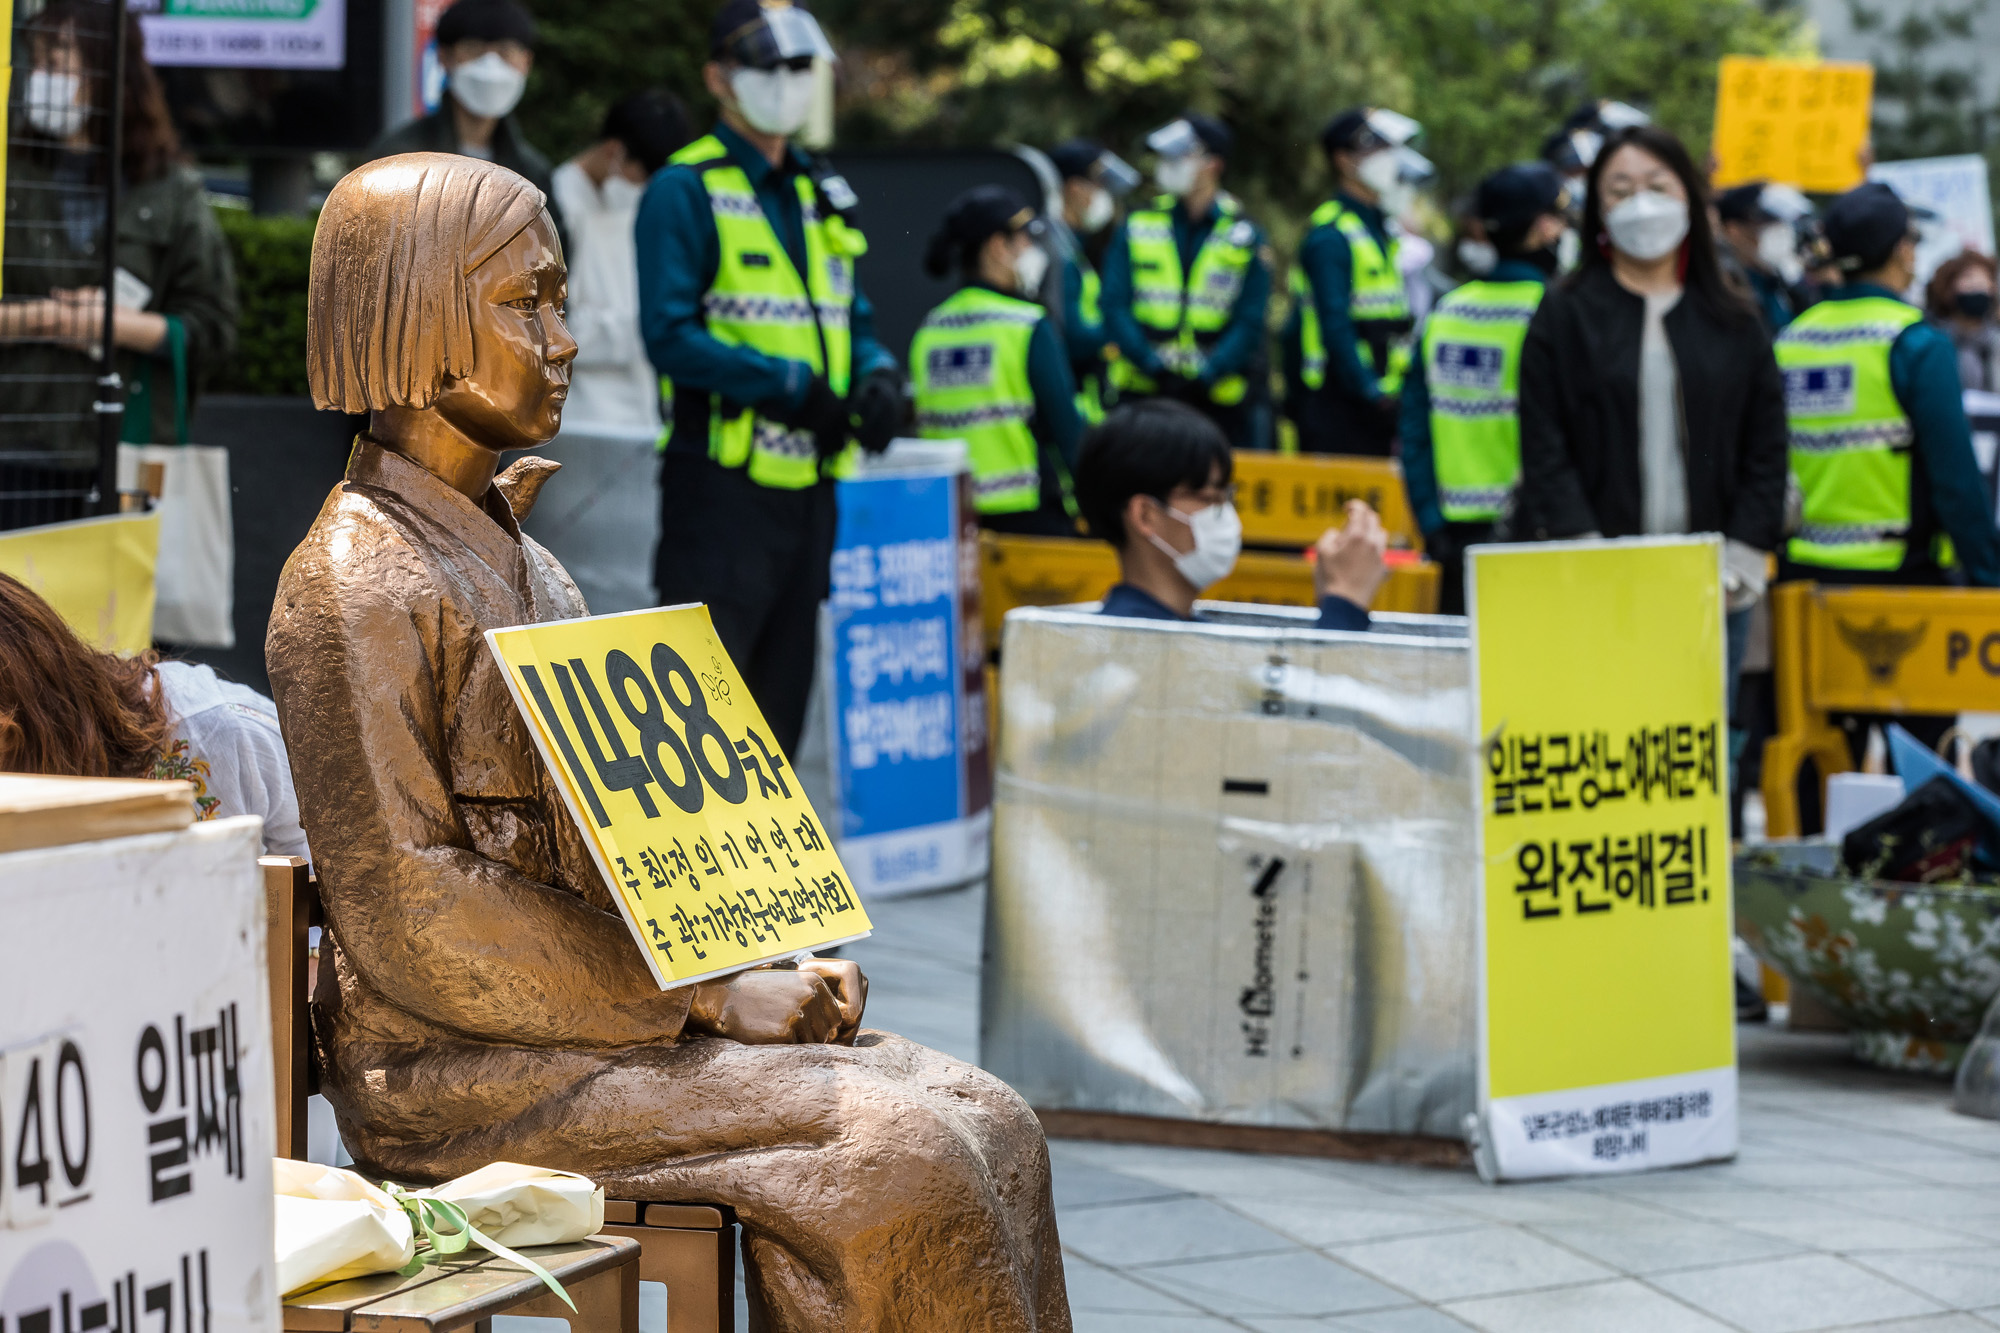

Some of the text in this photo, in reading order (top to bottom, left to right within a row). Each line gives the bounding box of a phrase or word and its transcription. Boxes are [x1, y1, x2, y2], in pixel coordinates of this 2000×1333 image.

[518, 642, 792, 829] 1488차
[1515, 826, 1709, 920] 완전해결!
[137, 1001, 244, 1204] 일째
